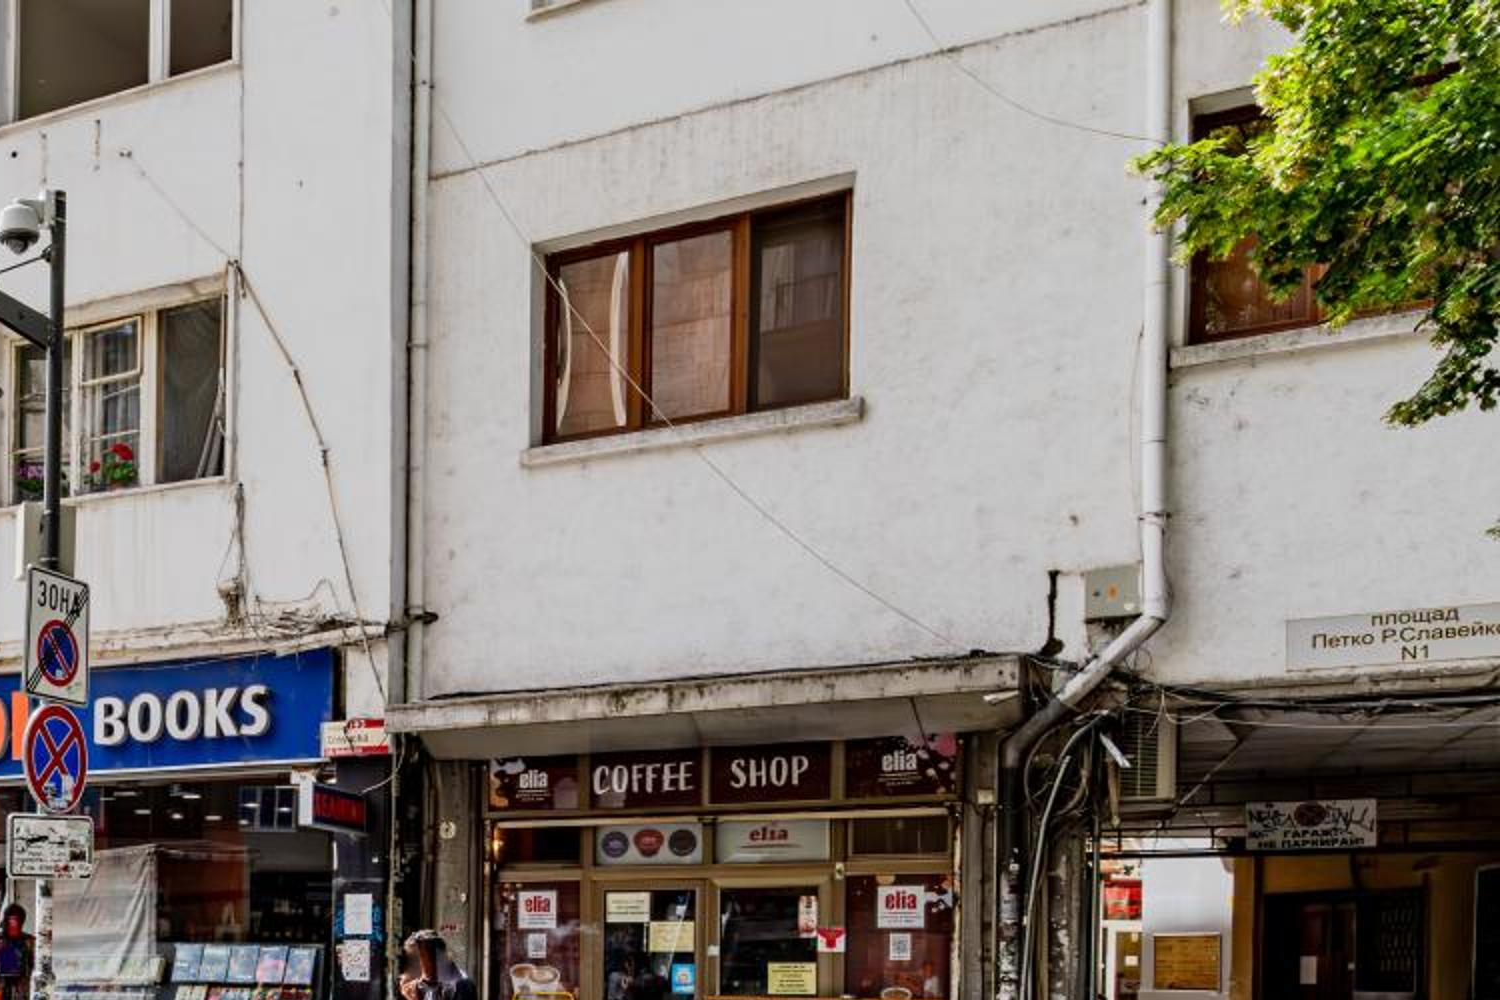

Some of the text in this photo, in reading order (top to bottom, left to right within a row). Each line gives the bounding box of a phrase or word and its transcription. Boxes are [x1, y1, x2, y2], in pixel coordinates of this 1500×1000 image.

[37, 580, 82, 617] ЗОНА
[1371, 607, 1460, 627] площад
[1311, 632, 1375, 650] Петко
[93, 685, 270, 746] BOOKS
[882, 750, 917, 772] elia
[519, 769, 549, 789] elia
[593, 755, 809, 795] COFFEE SHOP
[749, 826, 789, 842] elia
[525, 895, 551, 913] elia
[885, 890, 917, 910] elia
